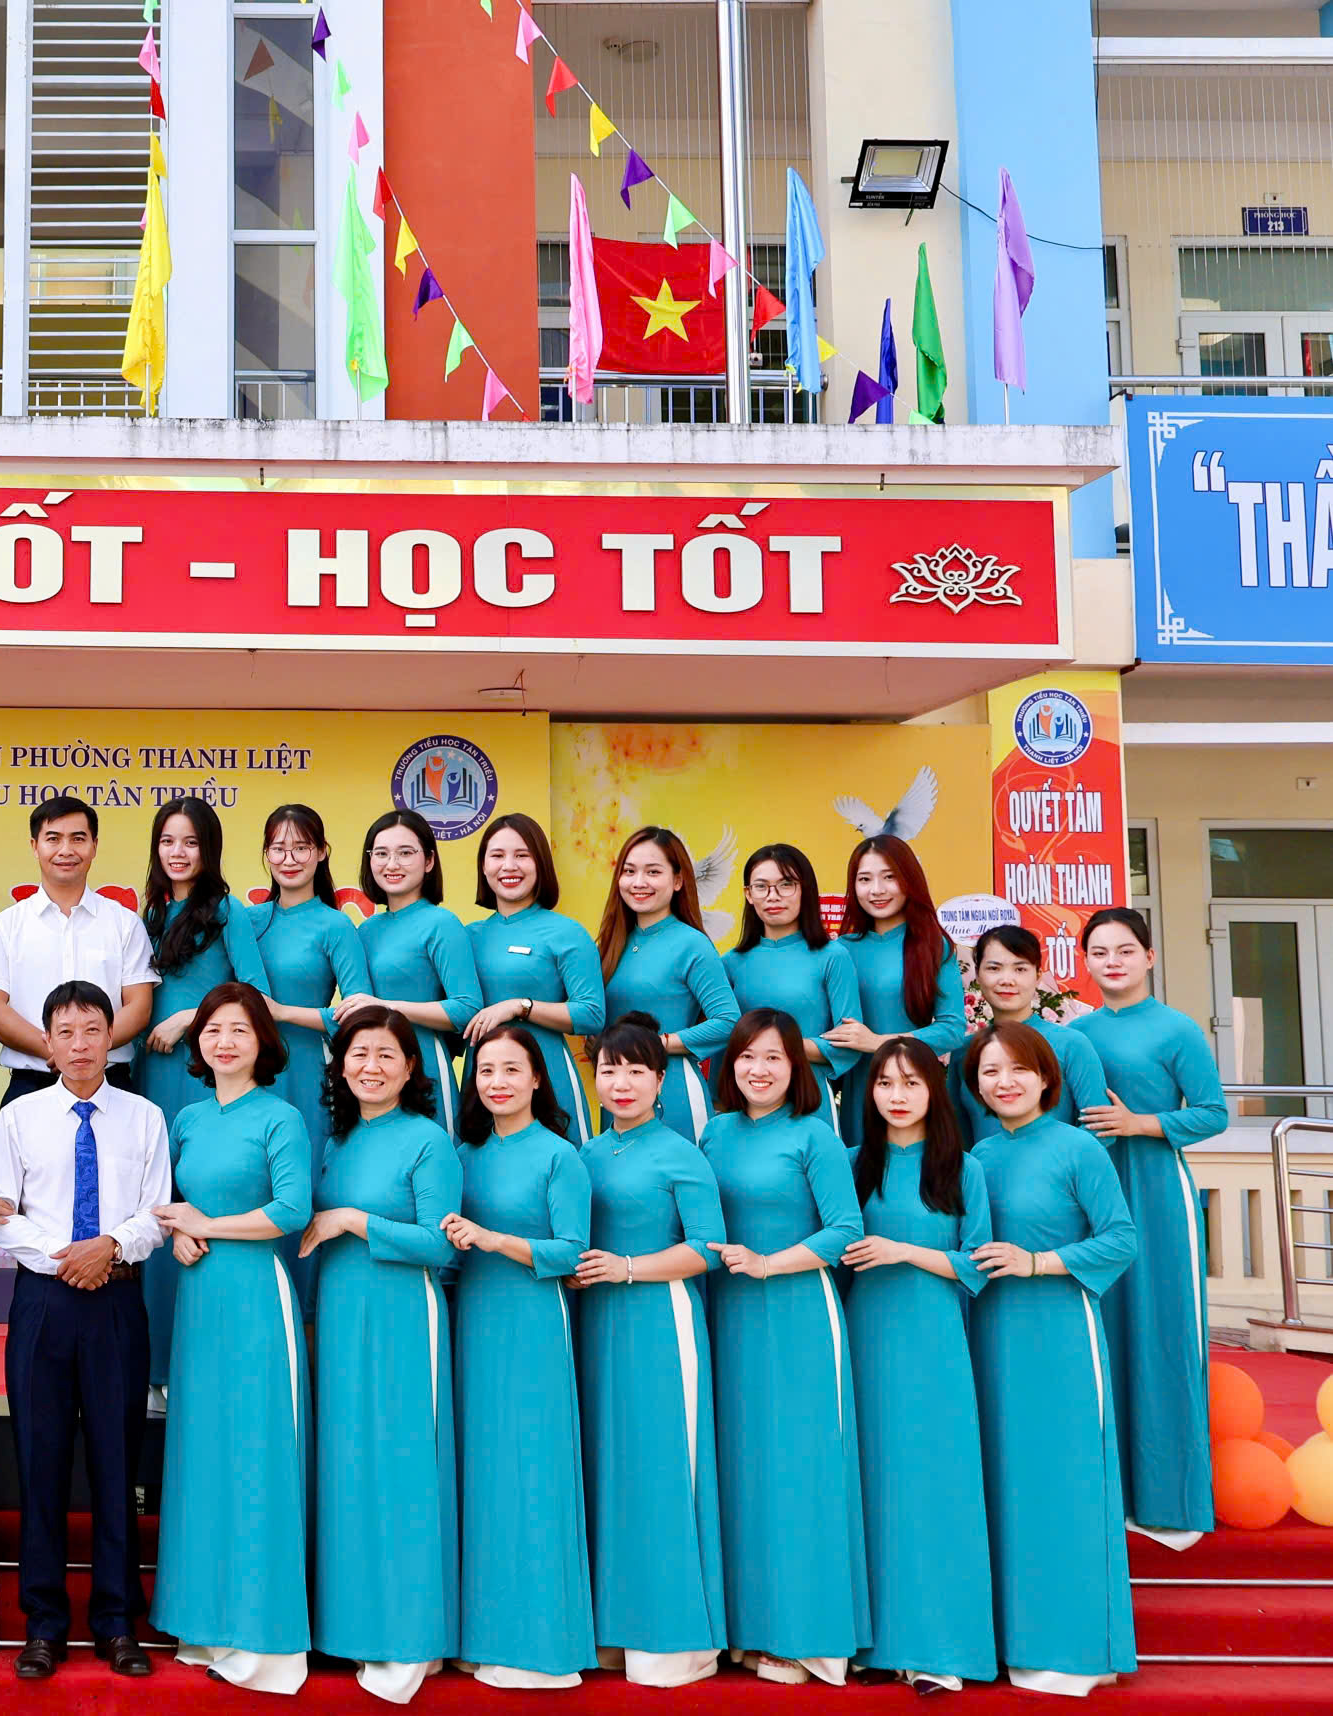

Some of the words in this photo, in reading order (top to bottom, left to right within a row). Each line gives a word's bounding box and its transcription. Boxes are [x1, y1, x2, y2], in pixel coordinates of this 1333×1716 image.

[1267, 221, 1284, 231] 213
[190, 561, 235, 578] -
[287, 528, 555, 628] HỌC
[601, 502, 842, 614] TỐT
[10, 739, 132, 769] PHƯỜNG
[139, 748, 240, 769] THANH
[247, 743, 311, 775] LIỆT
[418, 737, 439, 750] TIỂU
[441, 738, 460, 748] HỌC
[462, 743, 478, 757] TÂN
[1023, 744, 1043, 761] THANH
[87, 780, 143, 806] TÂN
[151, 777, 238, 807] TRIỀU
[1009, 778, 1061, 837] QUYẾT
[1065, 783, 1103, 833] TÂM
[460, 825, 473, 836] HÀ
[473, 812, 487, 827] NỘI
[1004, 855, 1052, 905] HOÀN
[1055, 855, 1113, 905] THÀNH
[941, 910, 957, 921] TRUNG
[958, 908, 969, 921] TÂM
[971, 909, 987, 921] NGOẠI
[988, 907, 999, 921] NGỮ
[1000, 909, 1016, 920] ROYAL
[1046, 922, 1076, 979] TỐT
